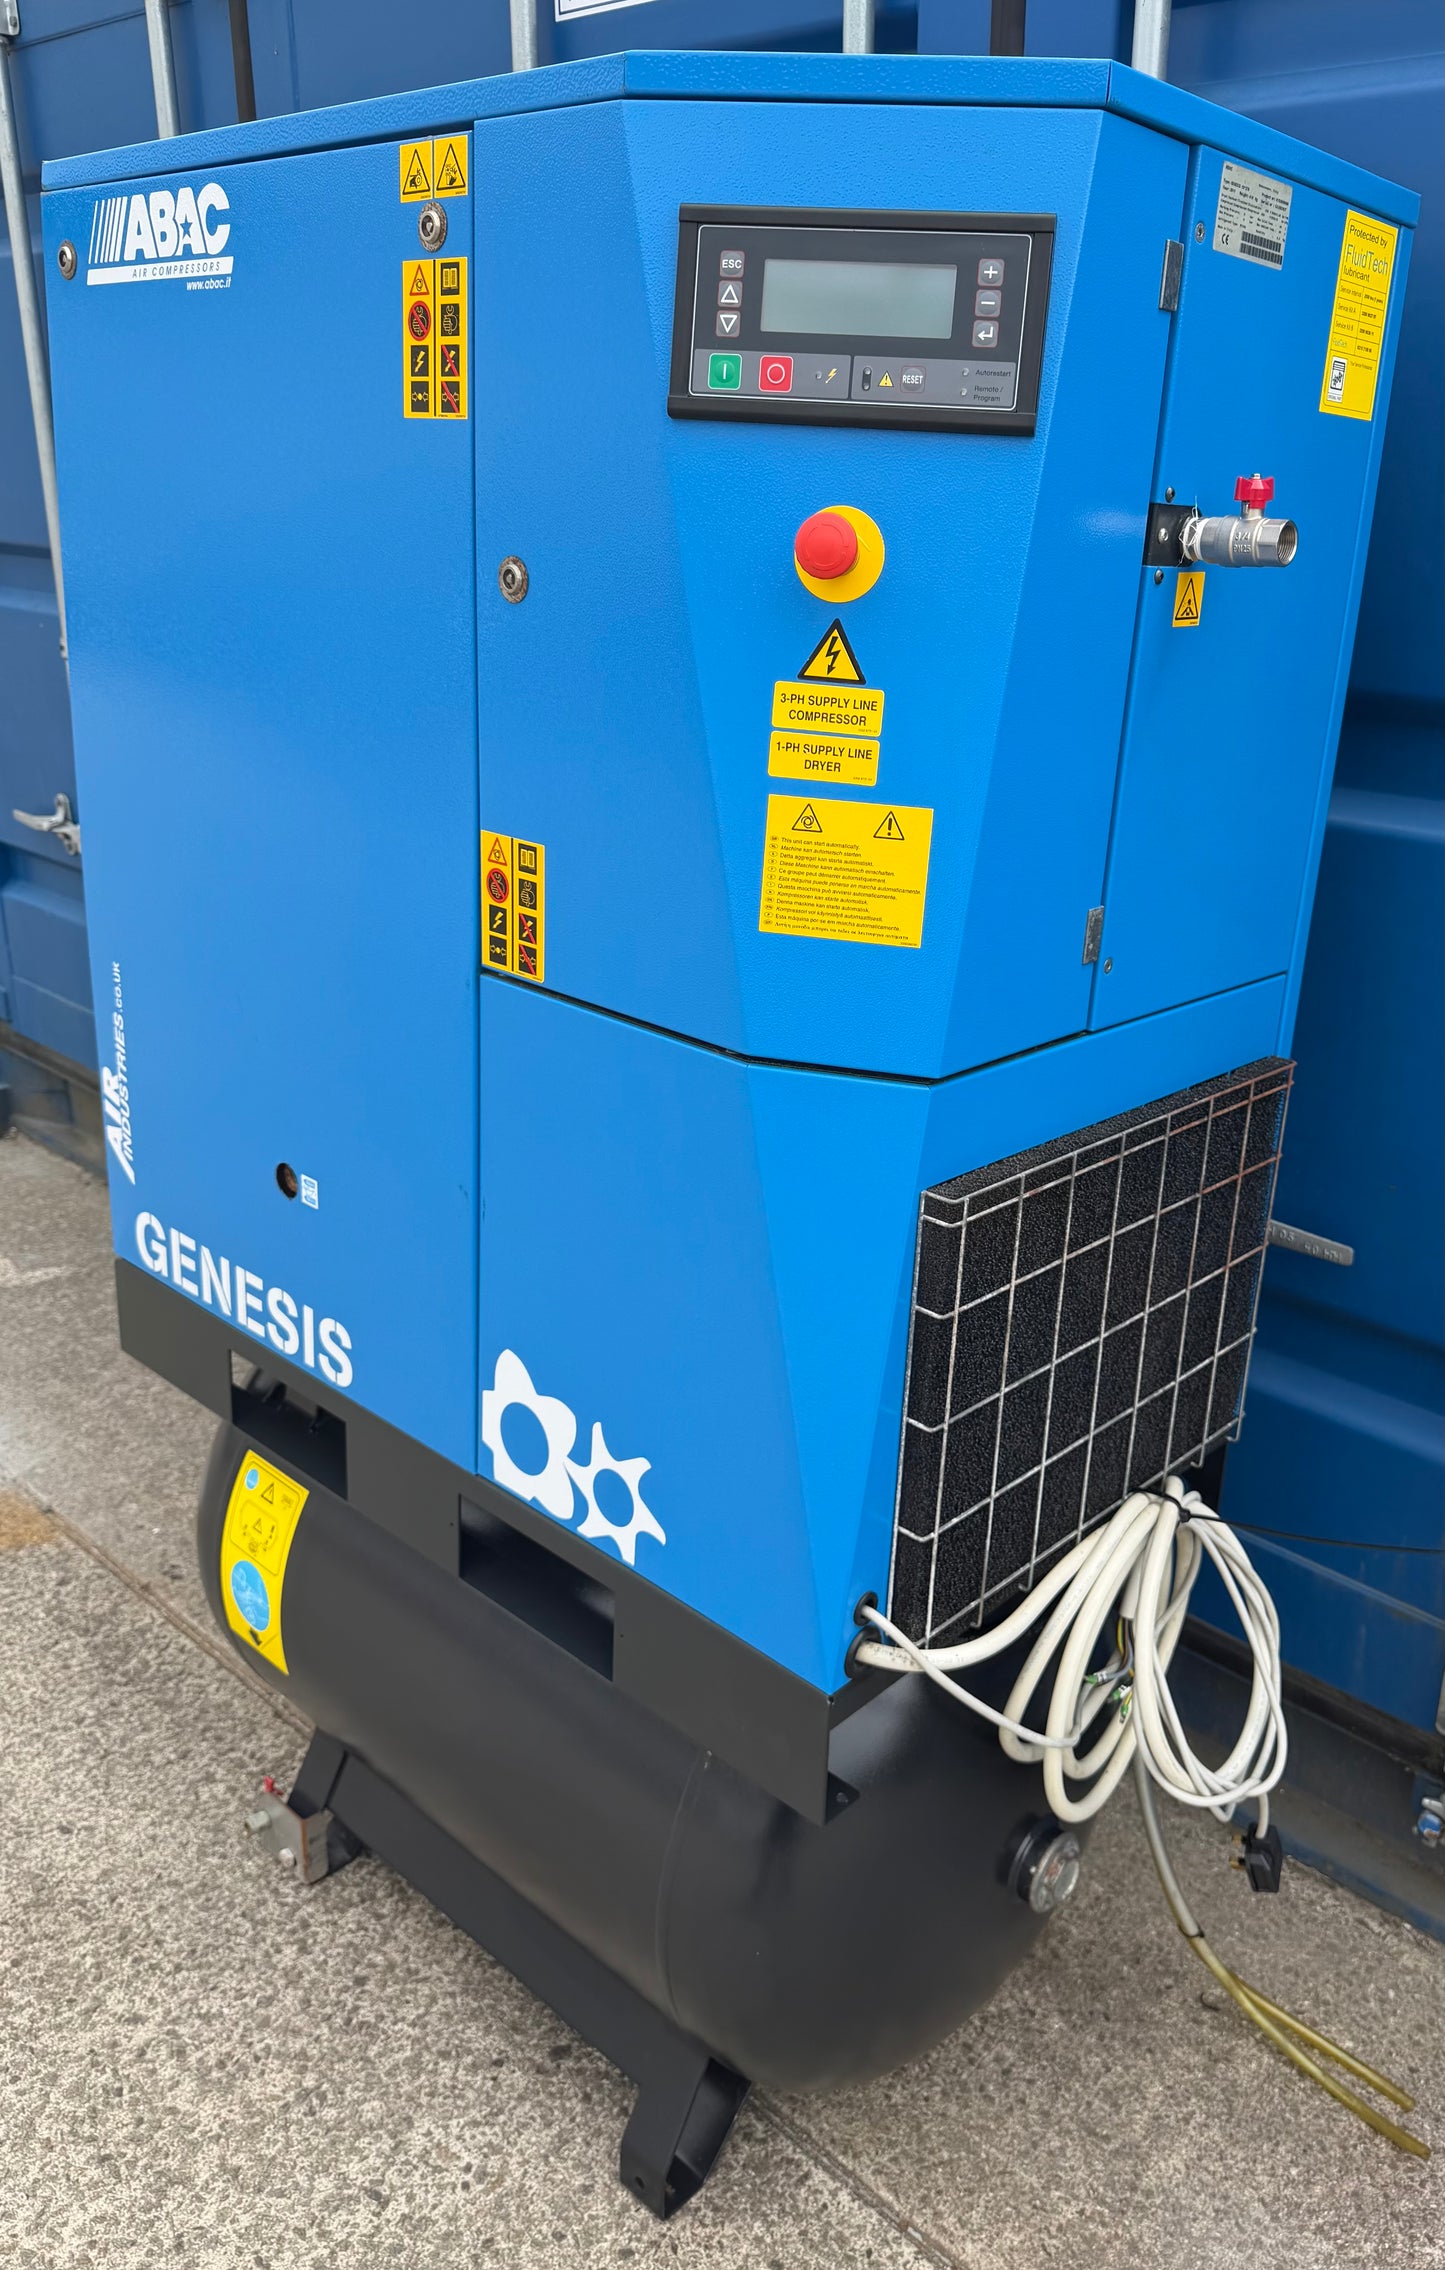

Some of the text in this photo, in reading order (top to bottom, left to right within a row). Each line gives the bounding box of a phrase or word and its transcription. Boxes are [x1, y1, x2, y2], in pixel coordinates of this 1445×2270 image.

[124, 182, 231, 261] ABAC
[1349, 225, 1388, 248] Protected by
[722, 259, 742, 269] ESC
[1345, 244, 1388, 275] FluidTech
[132, 261, 220, 278] AIR COMPRESSORS
[1344, 265, 1370, 282] lubricant
[186, 277, 232, 291] www.abac.it
[902, 374, 923, 385] RESET
[975, 369, 1011, 377] Autorestart
[973, 394, 1001, 402] Program
[780, 693, 878, 711] 3-PH SUPPLY LINE
[788, 709, 867, 726] COMPRESSOR
[776, 741, 873, 760] 1-PH SUPPLY LINE
[804, 759, 841, 772] DRYER
[102, 1066, 136, 1186] AIR
[136, 1211, 353, 1388] GENESIS
